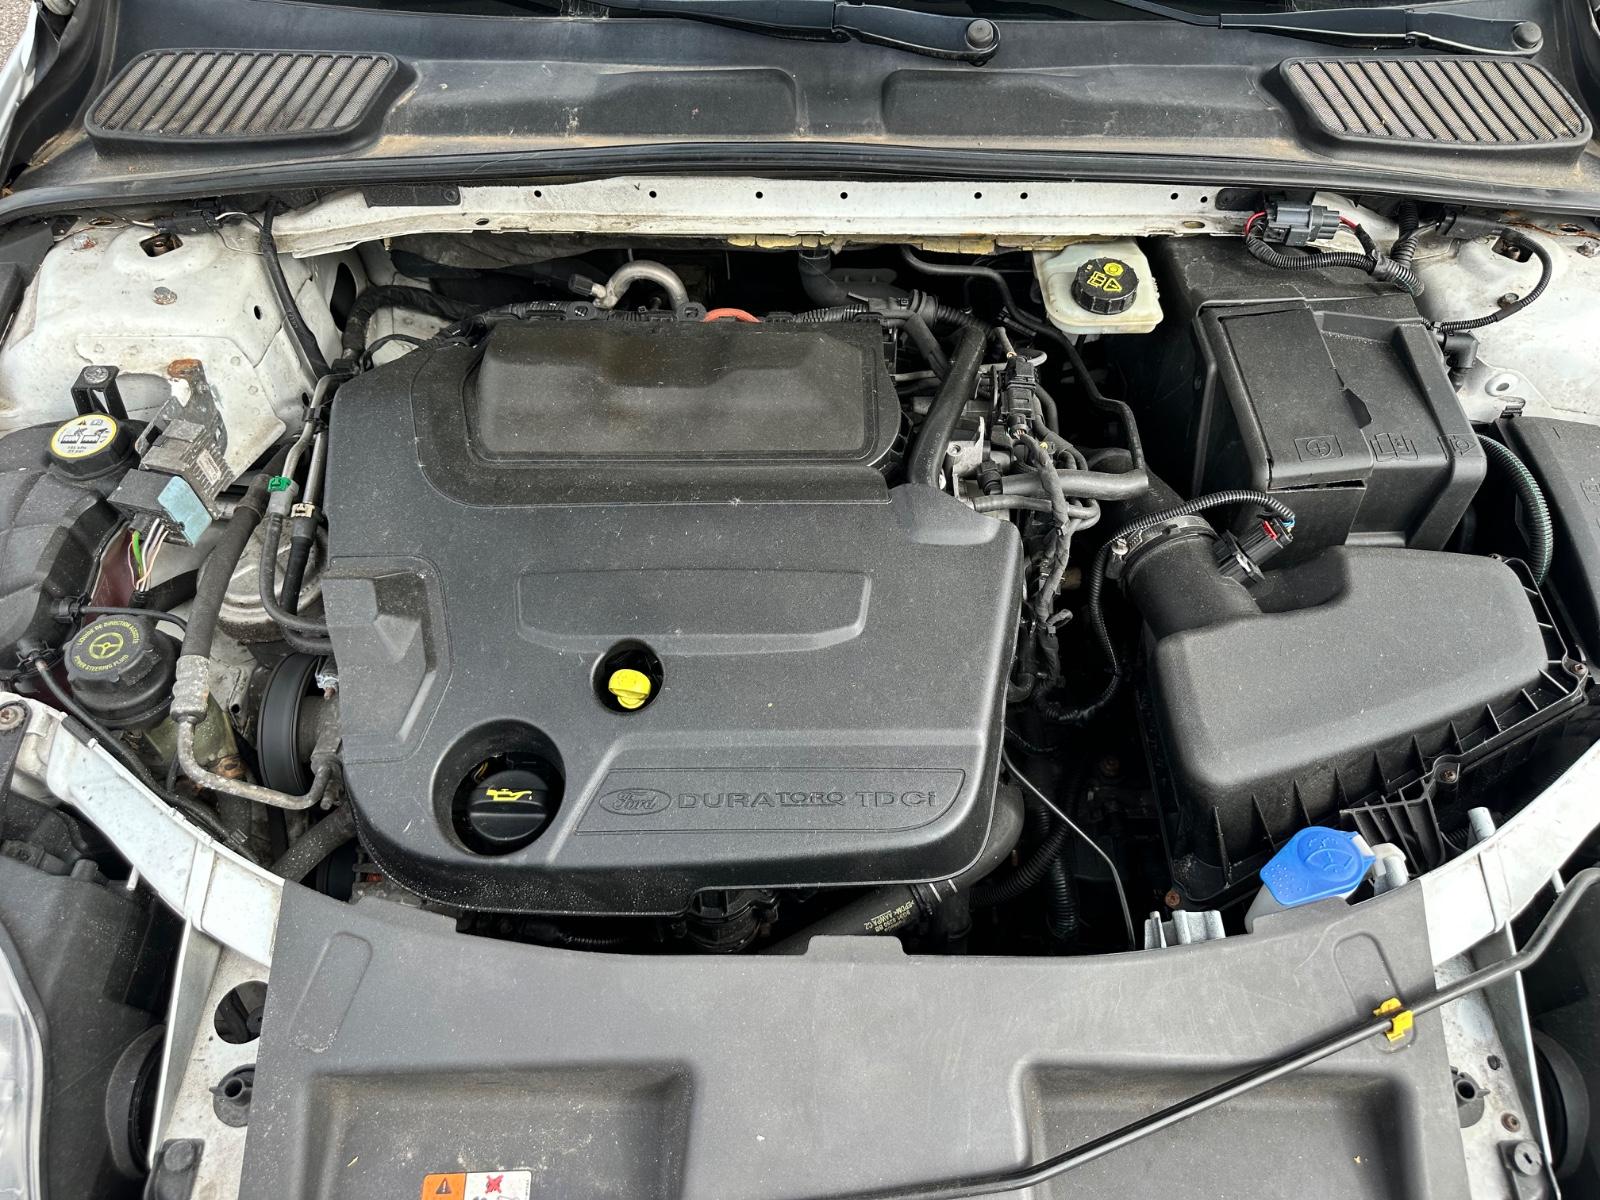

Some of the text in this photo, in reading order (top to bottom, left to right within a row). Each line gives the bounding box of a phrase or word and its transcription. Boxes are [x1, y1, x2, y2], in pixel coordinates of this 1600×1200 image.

[86, 663, 113, 672] STEERING
[113, 654, 129, 666] FLUID
[678, 790, 938, 809] DURATORQ TDCi
